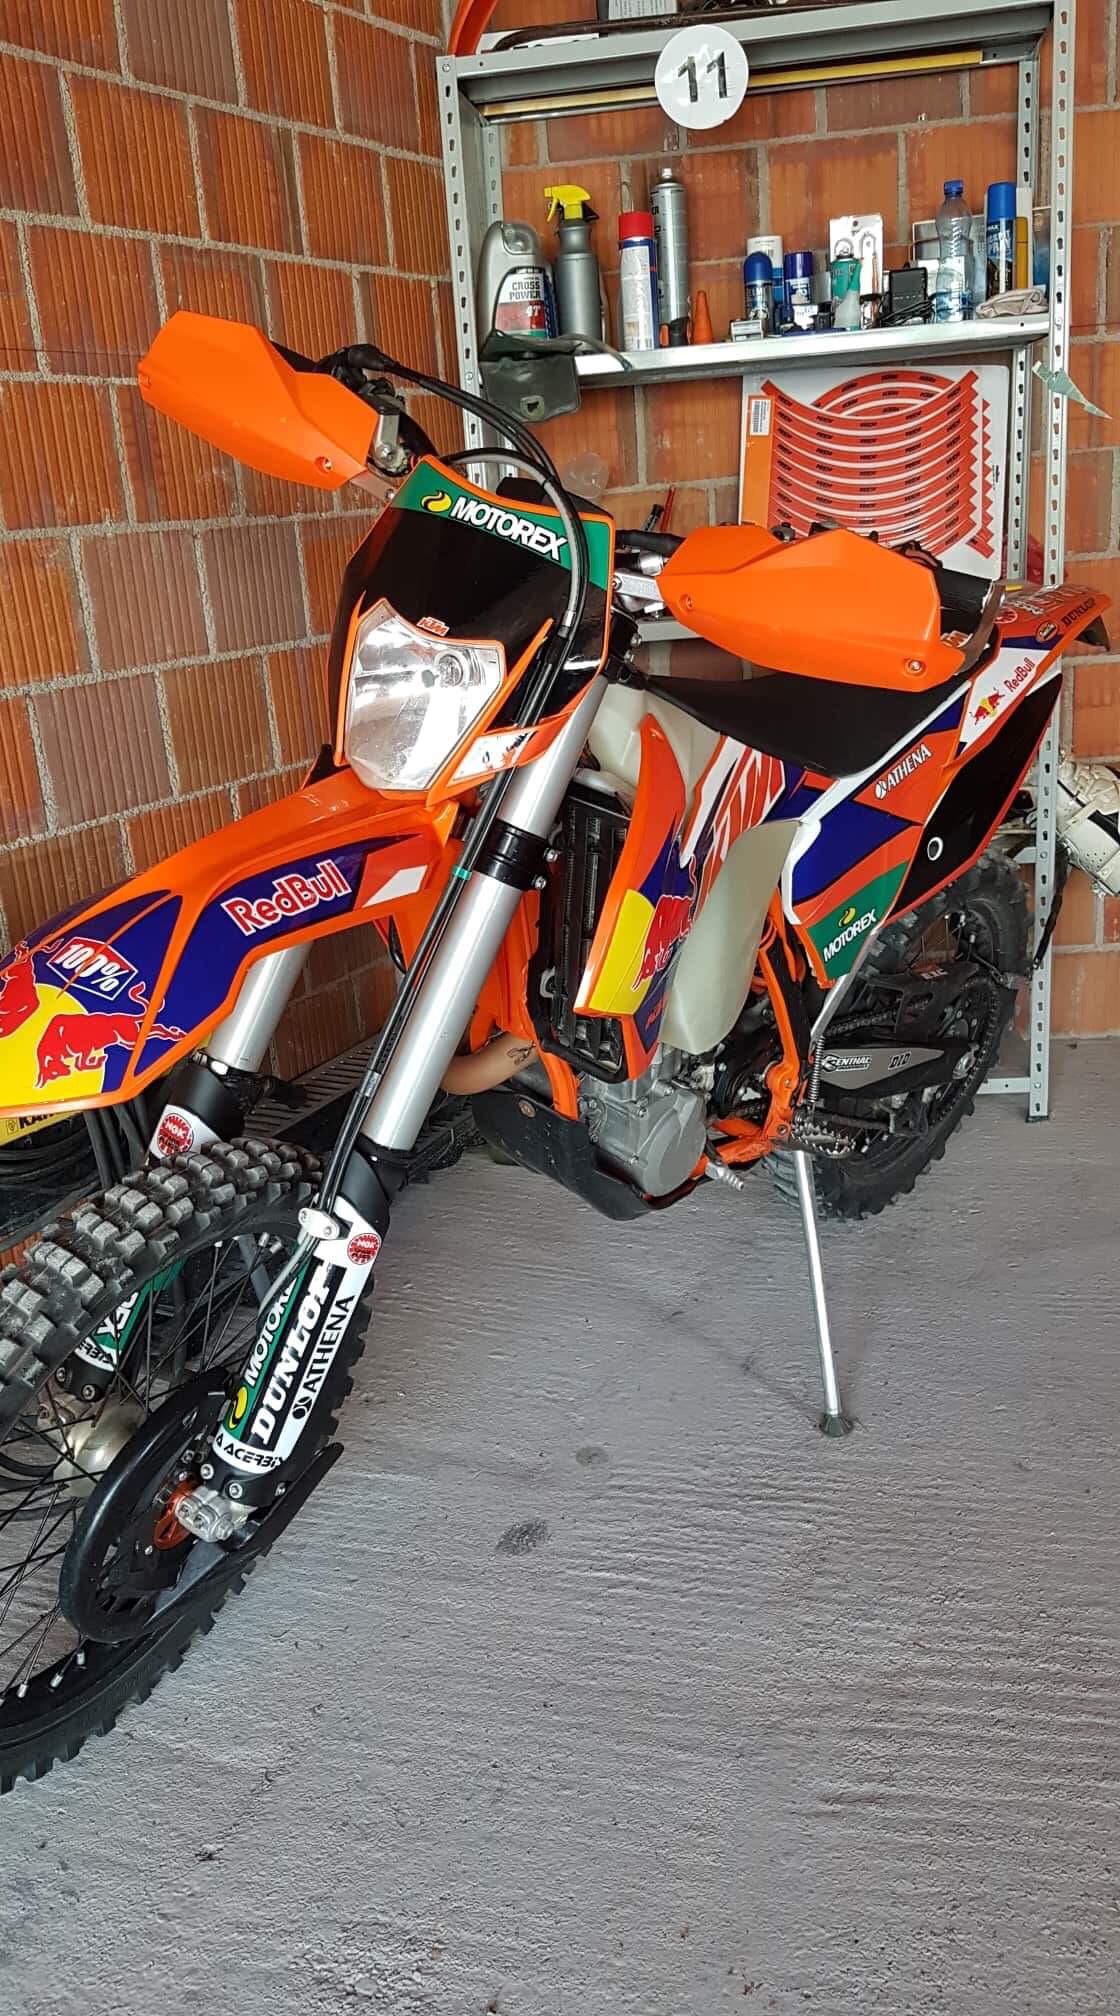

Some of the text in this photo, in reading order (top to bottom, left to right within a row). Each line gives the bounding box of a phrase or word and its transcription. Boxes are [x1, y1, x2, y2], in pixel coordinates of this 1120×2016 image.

[677, 51, 728, 103] 11
[509, 291, 542, 300] POWER
[511, 280, 541, 291] CROSS
[450, 496, 568, 560] MOTOREX
[418, 616, 449, 636] KTM
[886, 743, 932, 791] ATHENA
[824, 908, 877, 962] MOTOREX
[54, 944, 129, 991] 100%
[251, 1263, 331, 1445] DUNLOP
[302, 1294, 355, 1393] ATHENA
